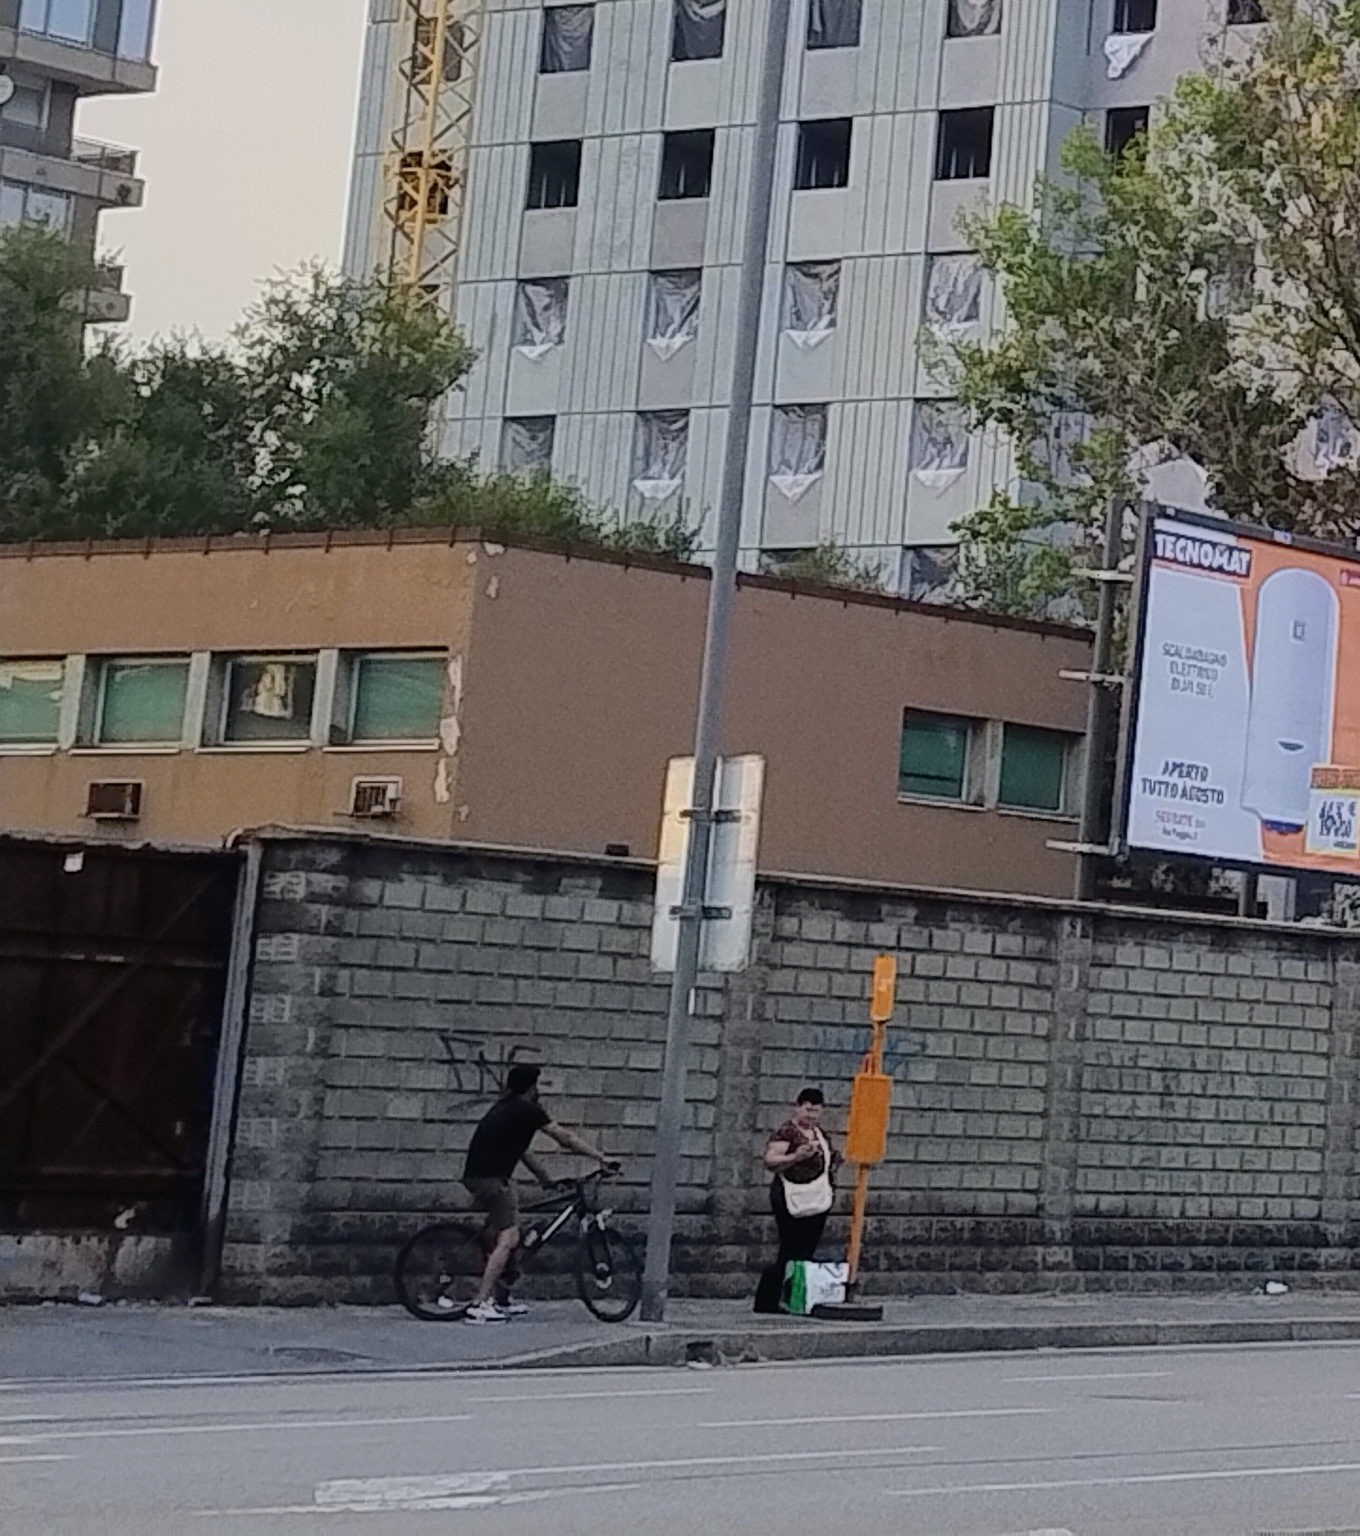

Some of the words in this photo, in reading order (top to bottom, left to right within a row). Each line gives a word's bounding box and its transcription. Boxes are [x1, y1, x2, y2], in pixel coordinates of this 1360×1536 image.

[1155, 533, 1251, 575] TECNOMAT
[1161, 761, 1209, 782] APERTO
[1141, 777, 1179, 798] TUTTO
[1180, 783, 1224, 804] AGOSTO
